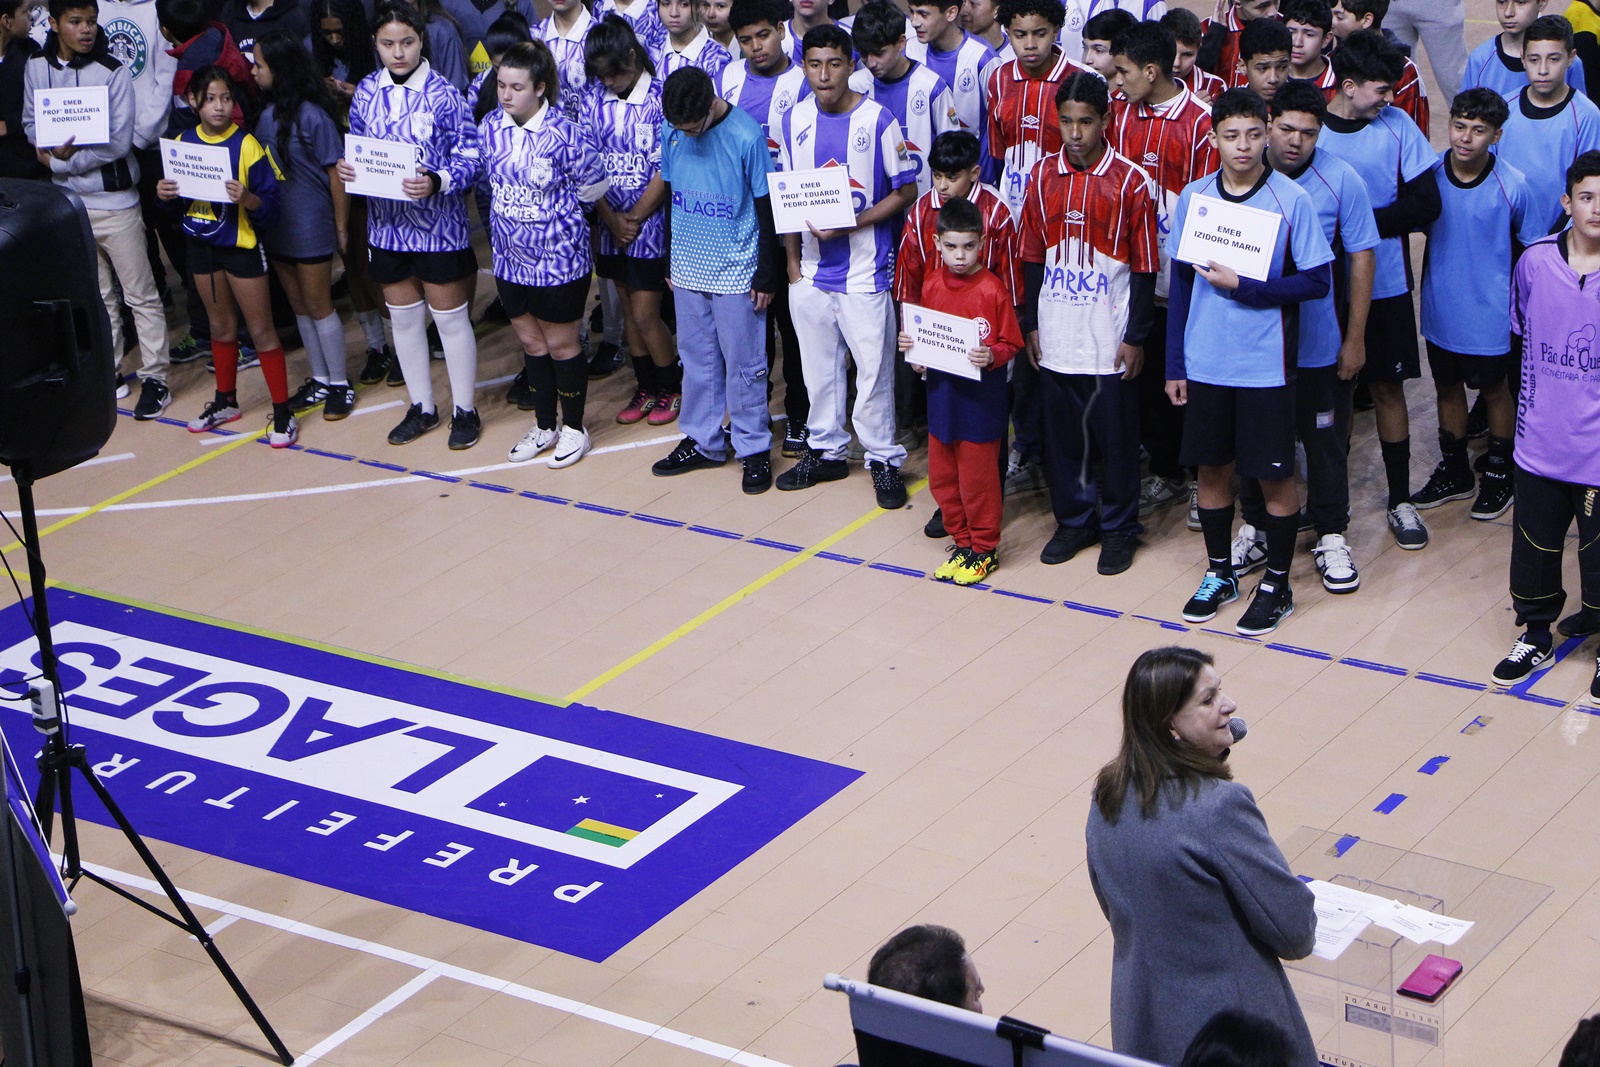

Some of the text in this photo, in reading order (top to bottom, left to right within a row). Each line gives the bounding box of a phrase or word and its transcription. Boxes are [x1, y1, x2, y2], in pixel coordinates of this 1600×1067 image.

[104, 21, 145, 51] WBUCKS
[184, 154, 203, 162] EMEB
[370, 150, 388, 158] EMEB
[169, 159, 224, 173] NOSSA SENHORA
[355, 157, 406, 170] ALINE GIOVANA
[187, 171, 222, 180] PRAZERES
[366, 167, 395, 176] SCHMITT
[804, 189, 840, 198] EDUARDO
[684, 198, 734, 220] LAGES
[783, 198, 840, 208] PEDRO AMARAL
[1217, 225, 1242, 237] EMEB
[1194, 230, 1261, 253] IZIDORO MARIN
[932, 322, 953, 333] EMEB
[918, 327, 965, 345] PROFESSORA
[917, 336, 967, 354] FAUSTA RATH
[1540, 342, 1558, 365] Pão
[1560, 345, 1574, 367] de
[0, 641, 497, 794] LAGES
[34, 744, 603, 904] PREFEITUR
